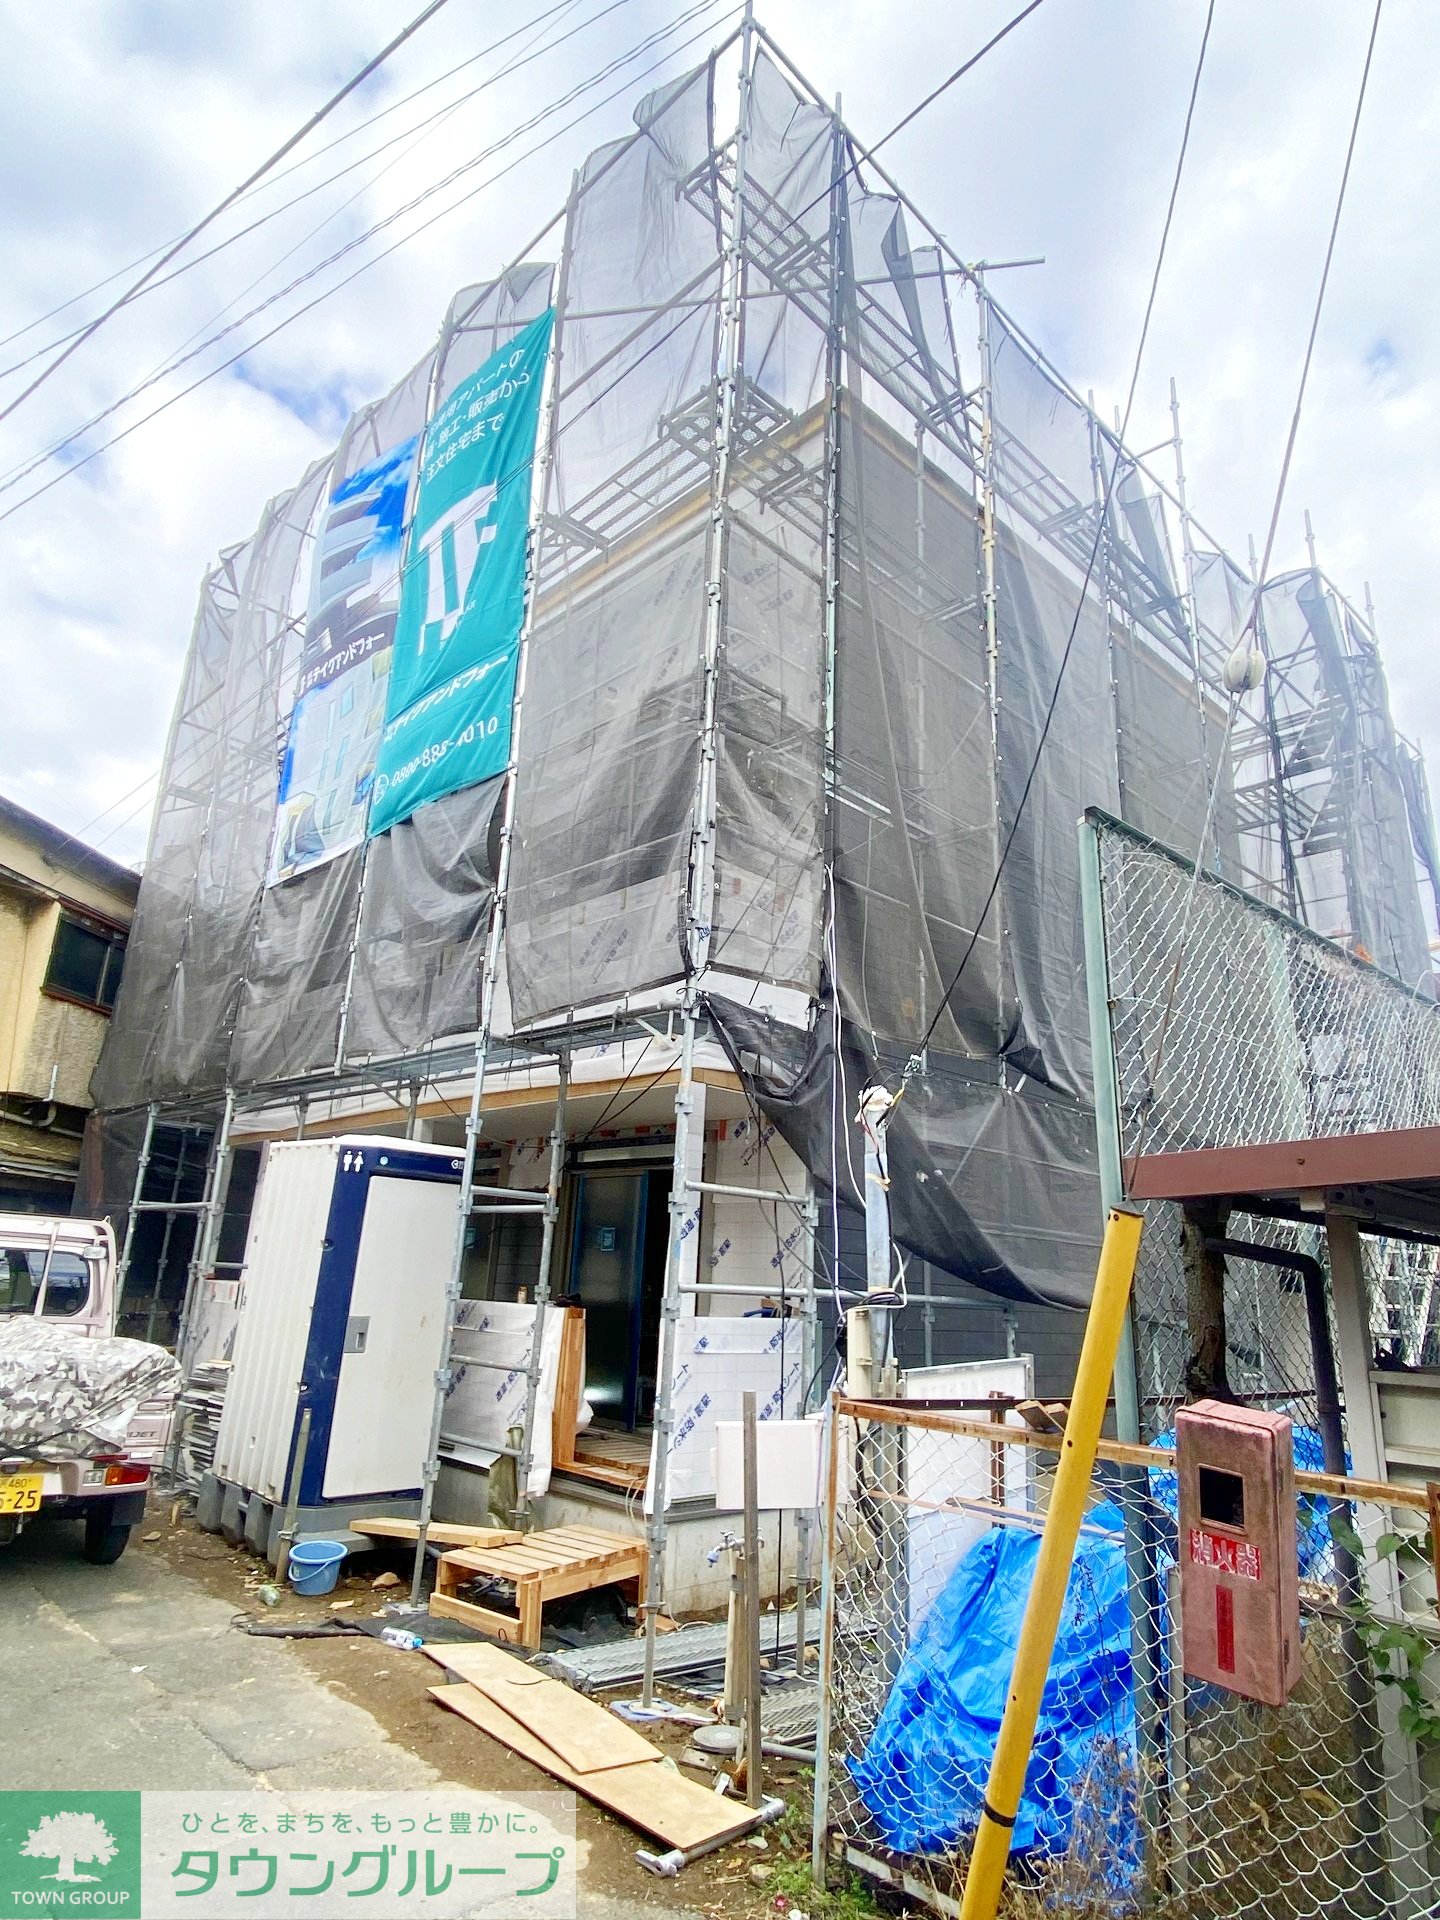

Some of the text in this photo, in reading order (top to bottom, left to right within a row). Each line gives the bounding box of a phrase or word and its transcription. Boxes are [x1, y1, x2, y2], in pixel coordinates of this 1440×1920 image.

[426, 412, 504, 485] 注文住宅まで
[9, 1478, 28, 1488] 480
[1191, 1529, 1259, 1580] 消火器
